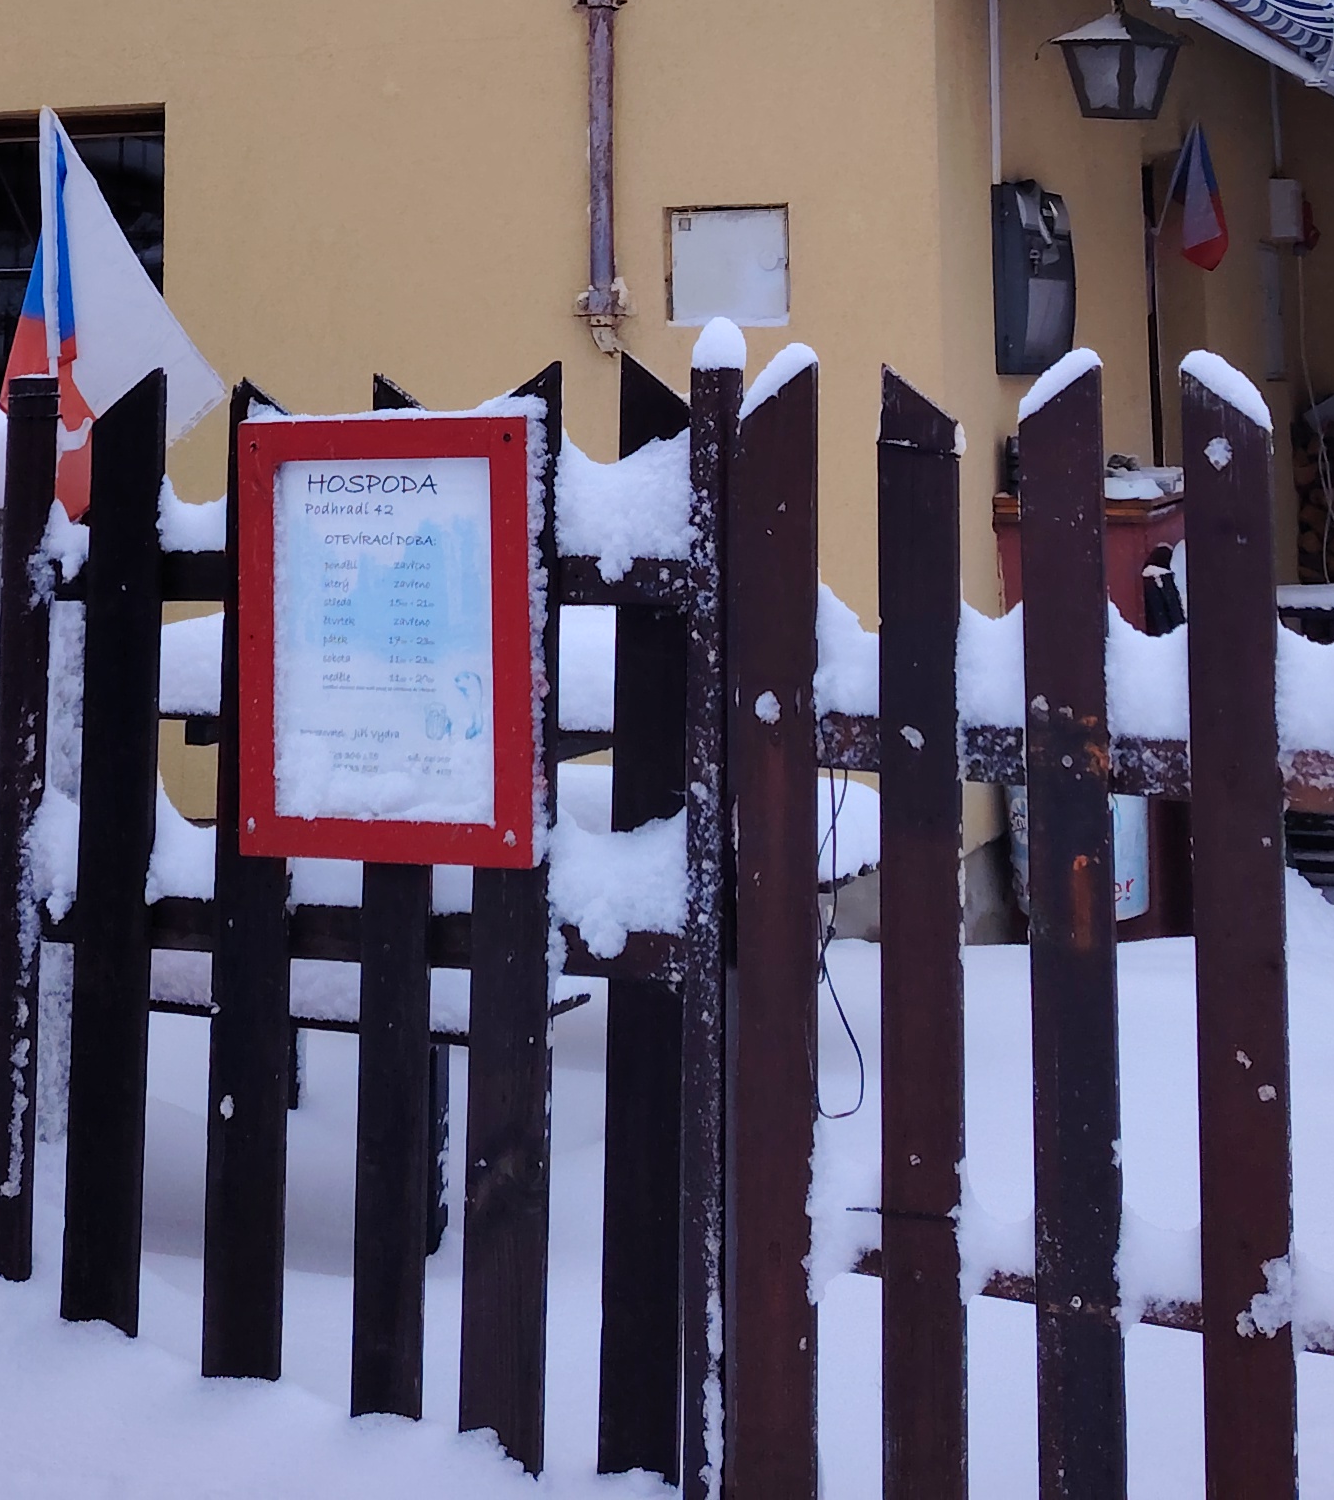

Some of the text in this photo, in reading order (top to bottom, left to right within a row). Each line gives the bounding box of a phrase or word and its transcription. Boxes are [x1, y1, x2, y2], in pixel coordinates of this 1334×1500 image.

[307, 473, 438, 495] HOSPODA
[304, 502, 394, 516] Podhradí 42
[324, 531, 437, 547] OTEVÍRACÍ DOBA:
[393, 579, 431, 590] zavřeno
